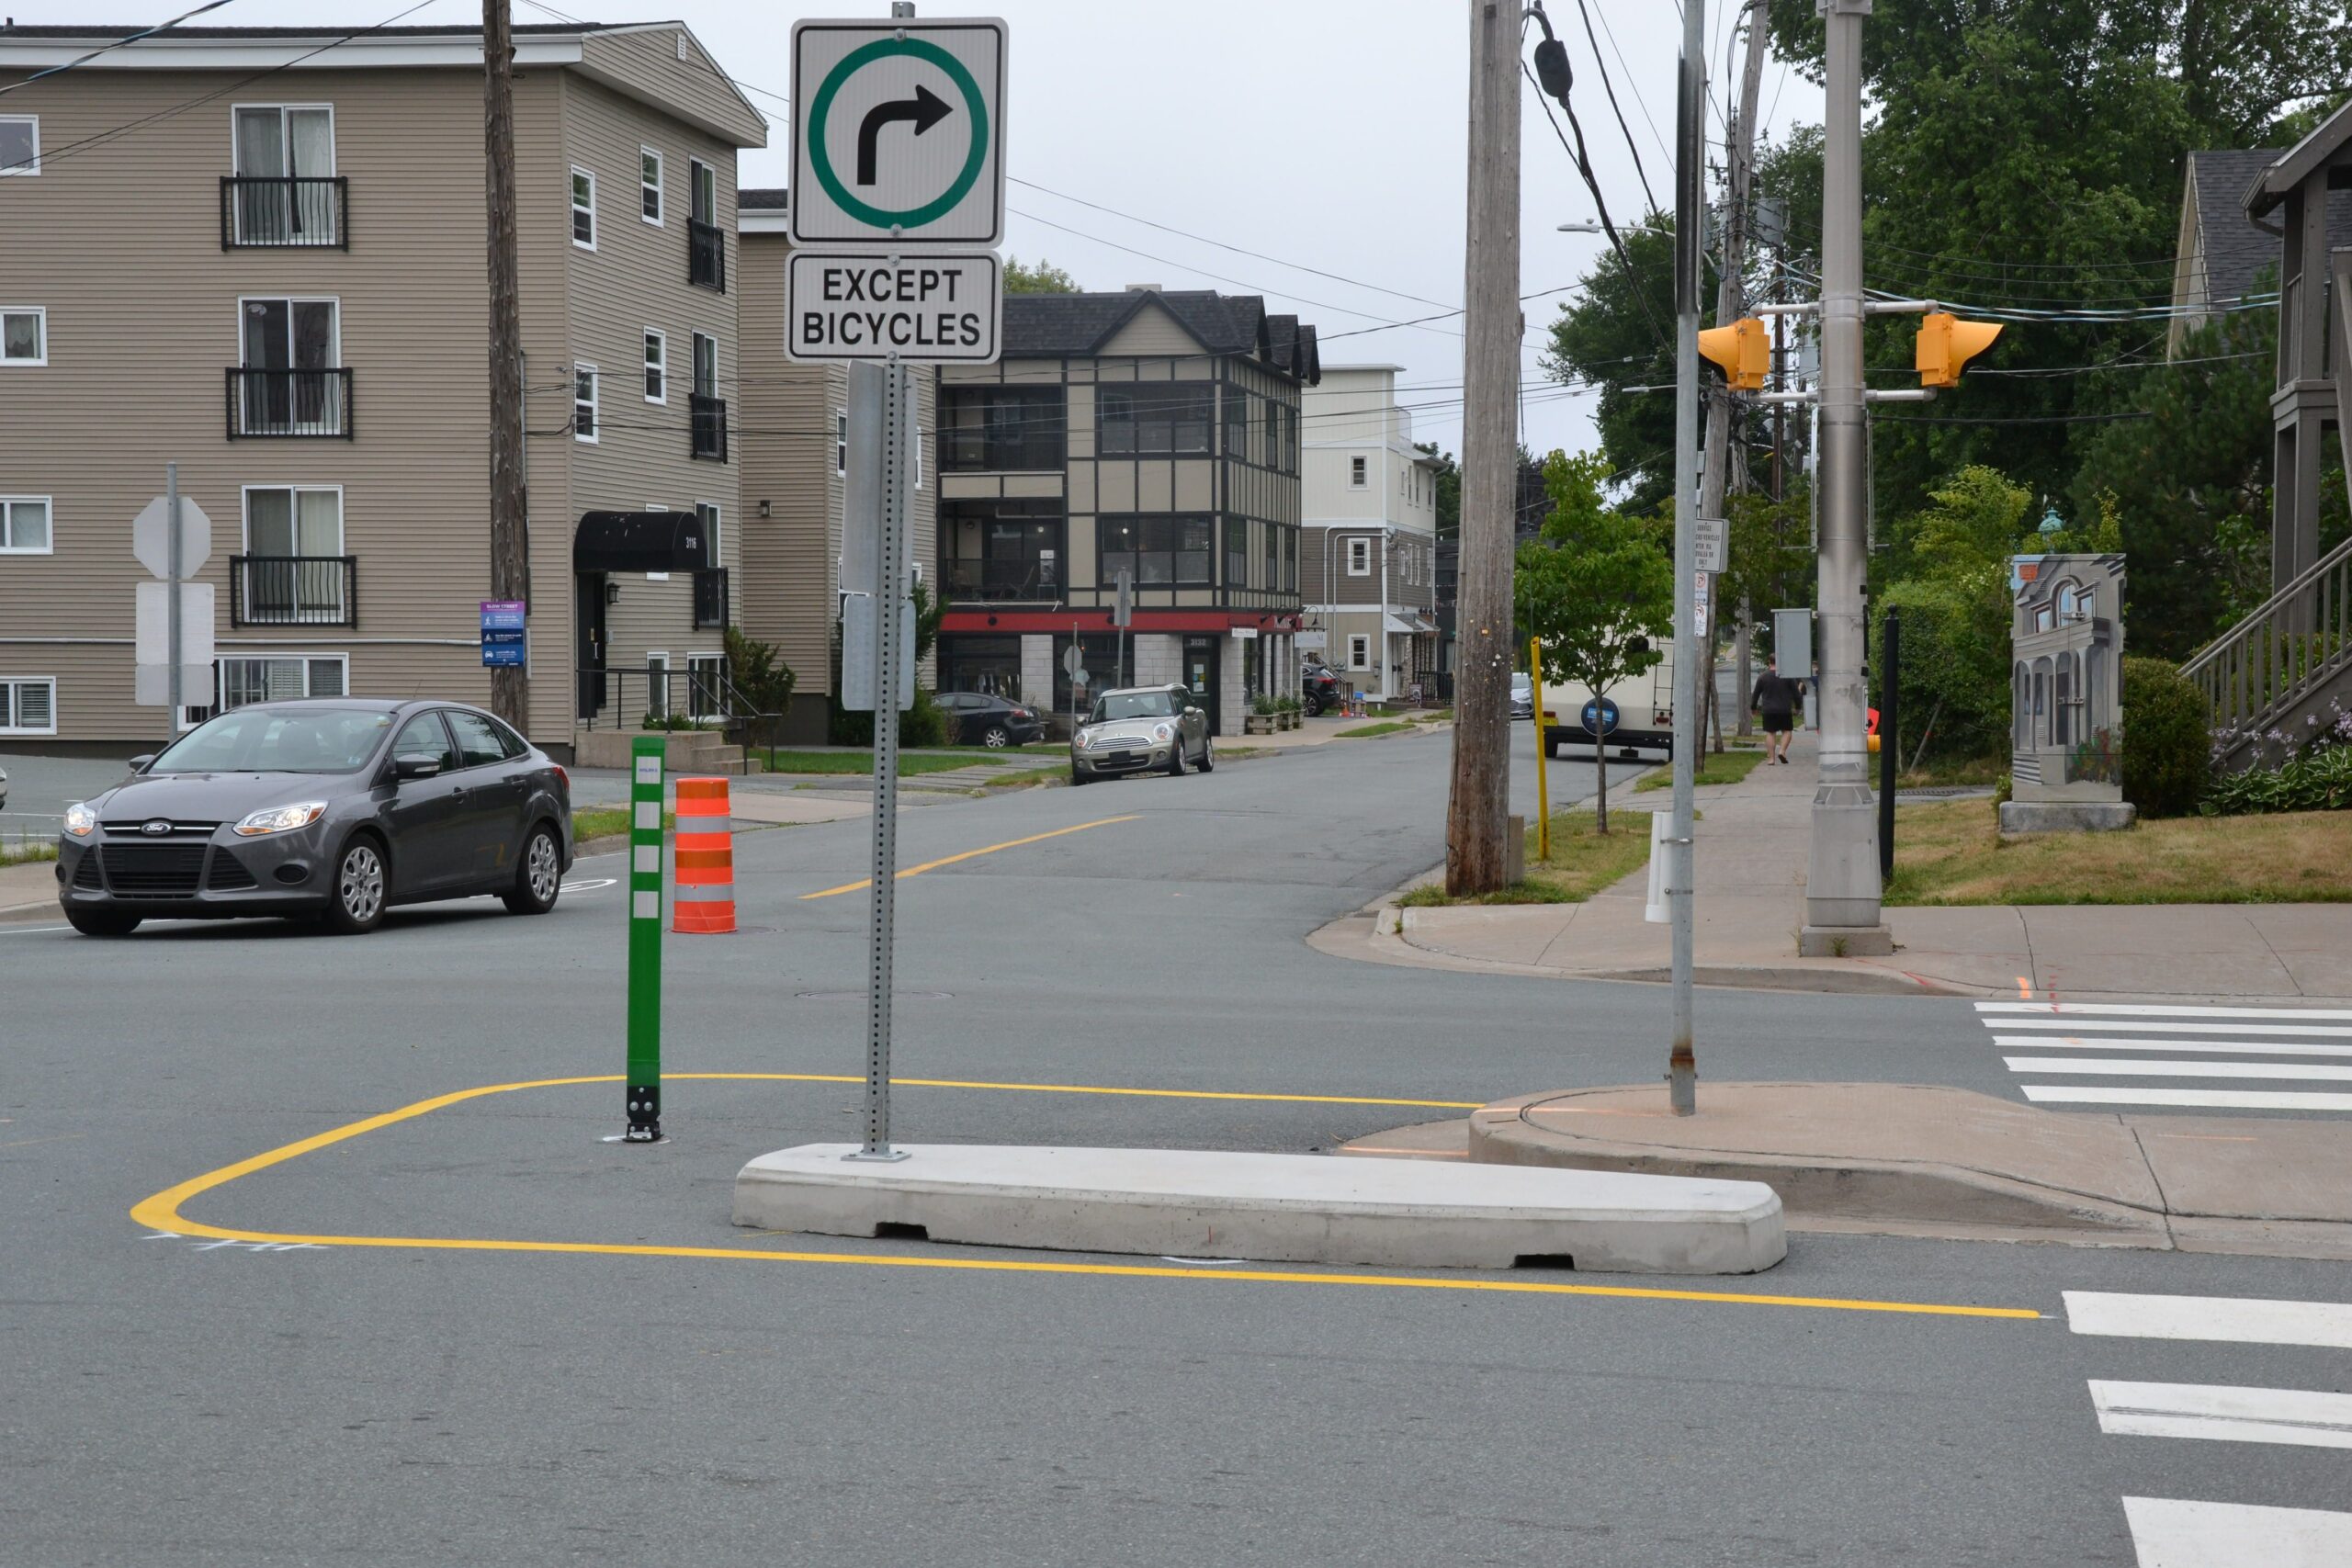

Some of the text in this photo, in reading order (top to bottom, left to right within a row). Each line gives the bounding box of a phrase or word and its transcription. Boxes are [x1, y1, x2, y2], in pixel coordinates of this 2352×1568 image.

[823, 268, 963, 302] EXCEPT
[803, 311, 981, 346] BICYCLES
[685, 536, 696, 549] 3116
